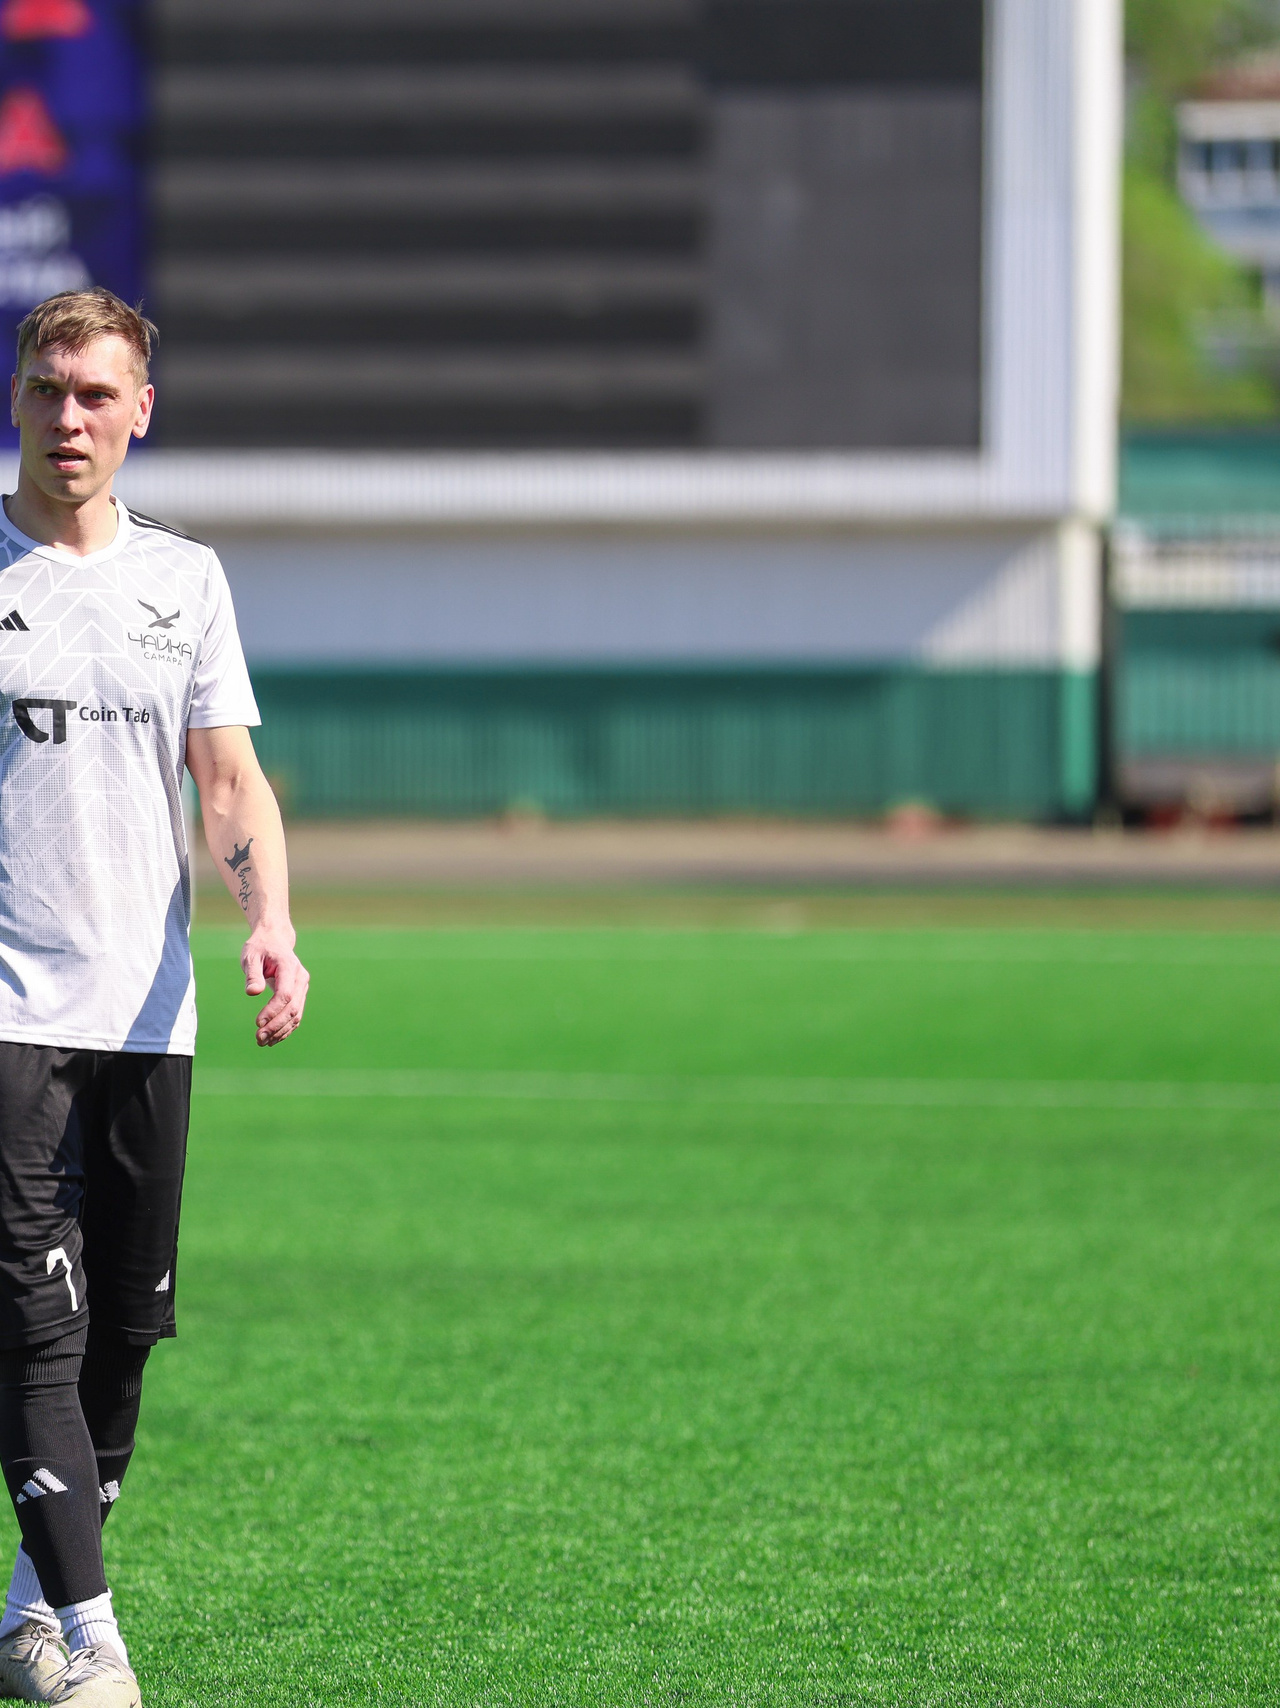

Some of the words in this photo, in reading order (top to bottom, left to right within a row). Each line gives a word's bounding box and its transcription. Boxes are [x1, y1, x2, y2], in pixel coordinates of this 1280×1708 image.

[127, 632, 193, 660] ЧАЙКА
[143, 651, 183, 667] САМАРА
[79, 706, 118, 722] Coin
[122, 707, 151, 724] Tab
[237, 866, 253, 911] King
